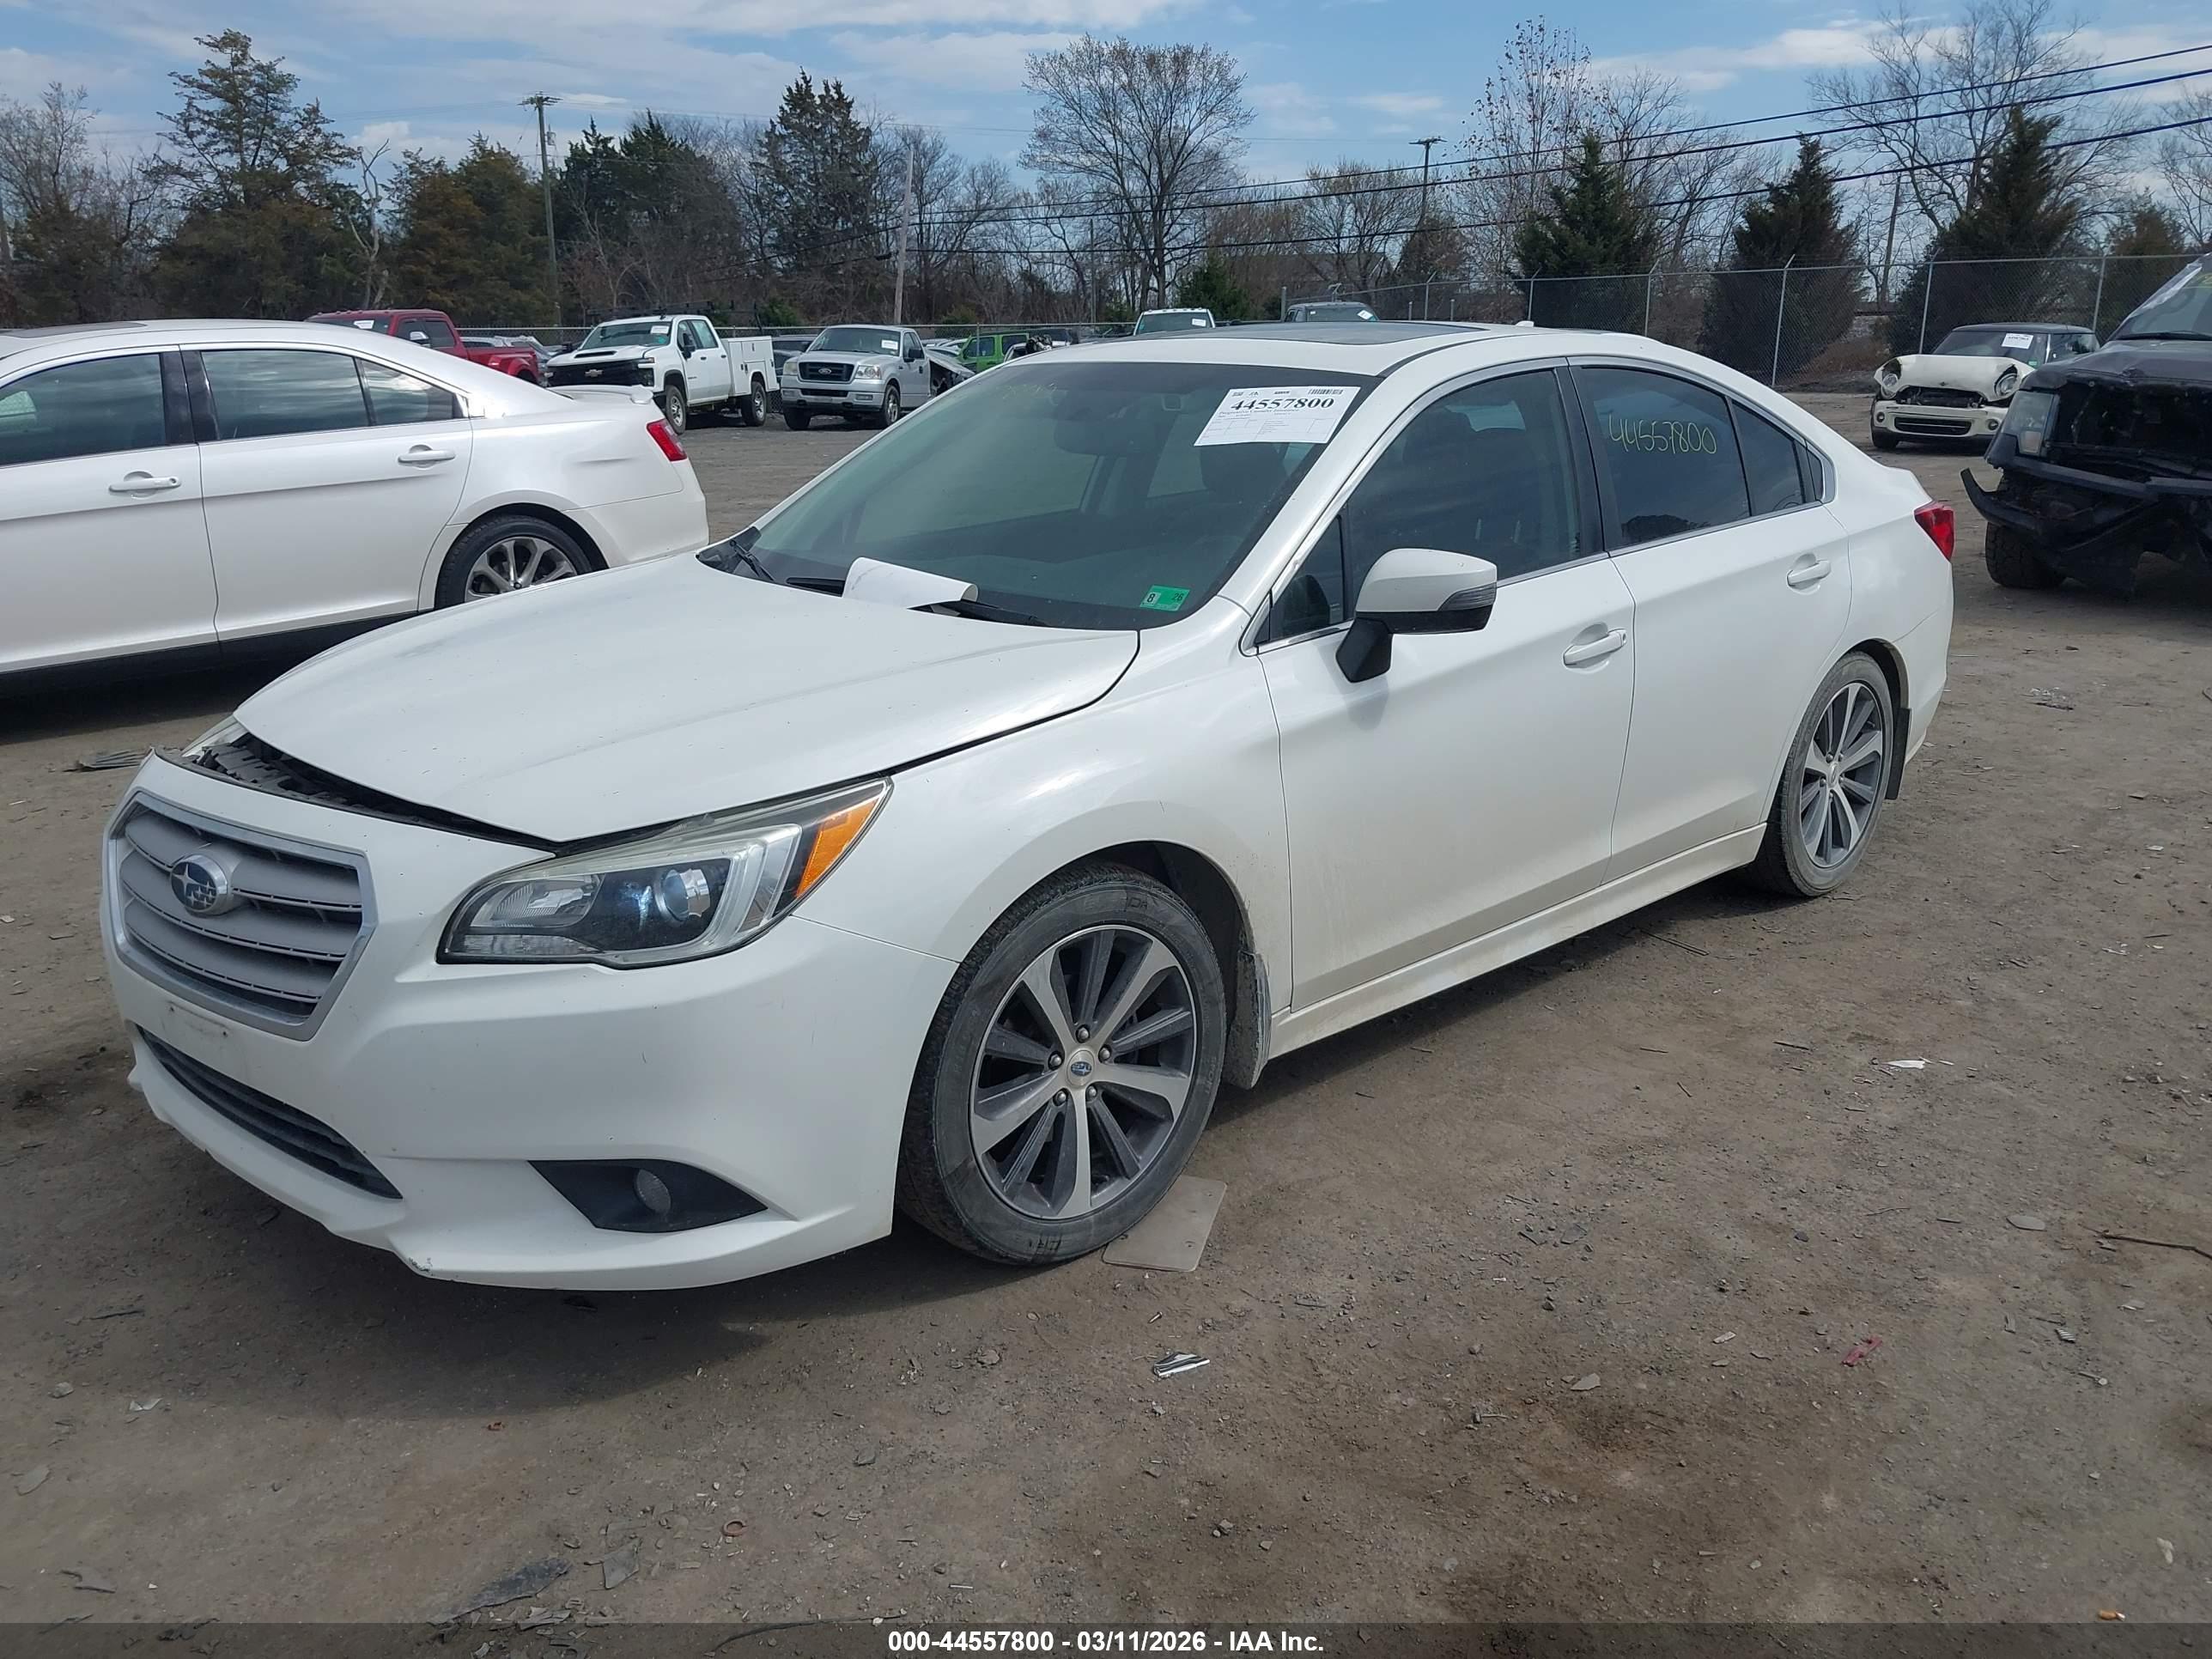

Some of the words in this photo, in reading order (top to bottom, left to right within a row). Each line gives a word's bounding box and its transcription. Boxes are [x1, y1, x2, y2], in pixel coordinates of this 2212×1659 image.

[1231, 398, 1334, 410] 44557800
[1608, 414, 1717, 454] 44557800
[1146, 592, 1156, 603] 8
